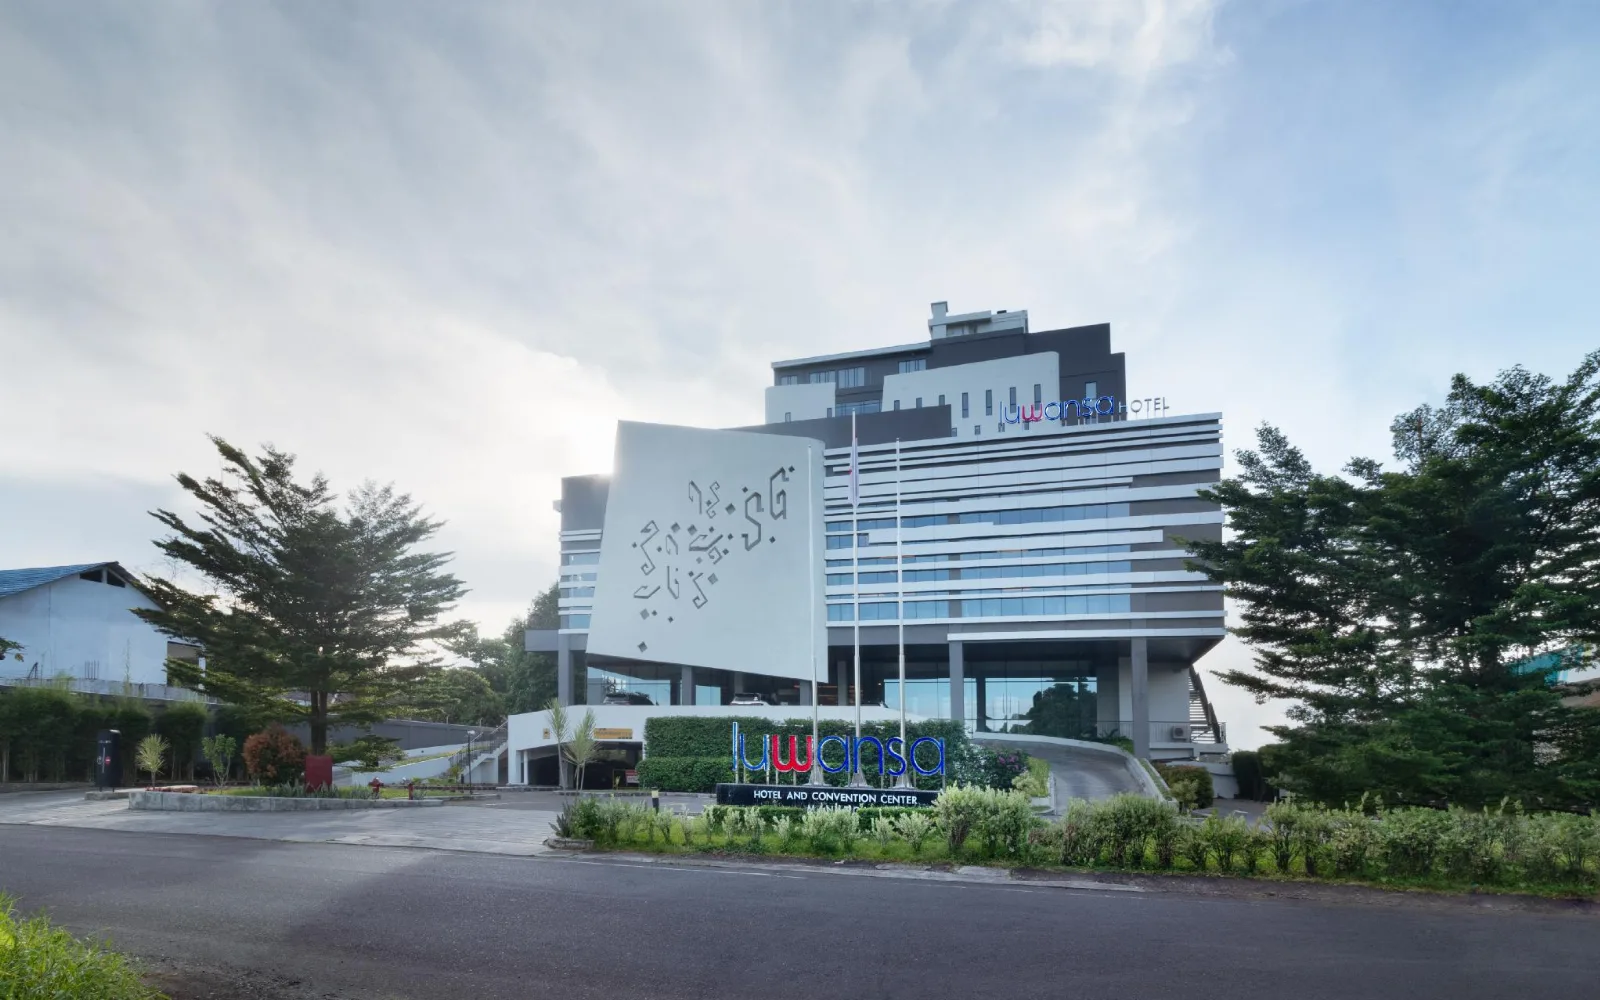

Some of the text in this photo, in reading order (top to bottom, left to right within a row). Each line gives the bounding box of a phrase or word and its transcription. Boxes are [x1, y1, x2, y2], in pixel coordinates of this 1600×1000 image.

[1000, 395, 1170, 425] luwansa HOTEL
[732, 721, 945, 776] luwansa
[753, 789, 918, 805] HOTEL AND CONVENTION CENTER
